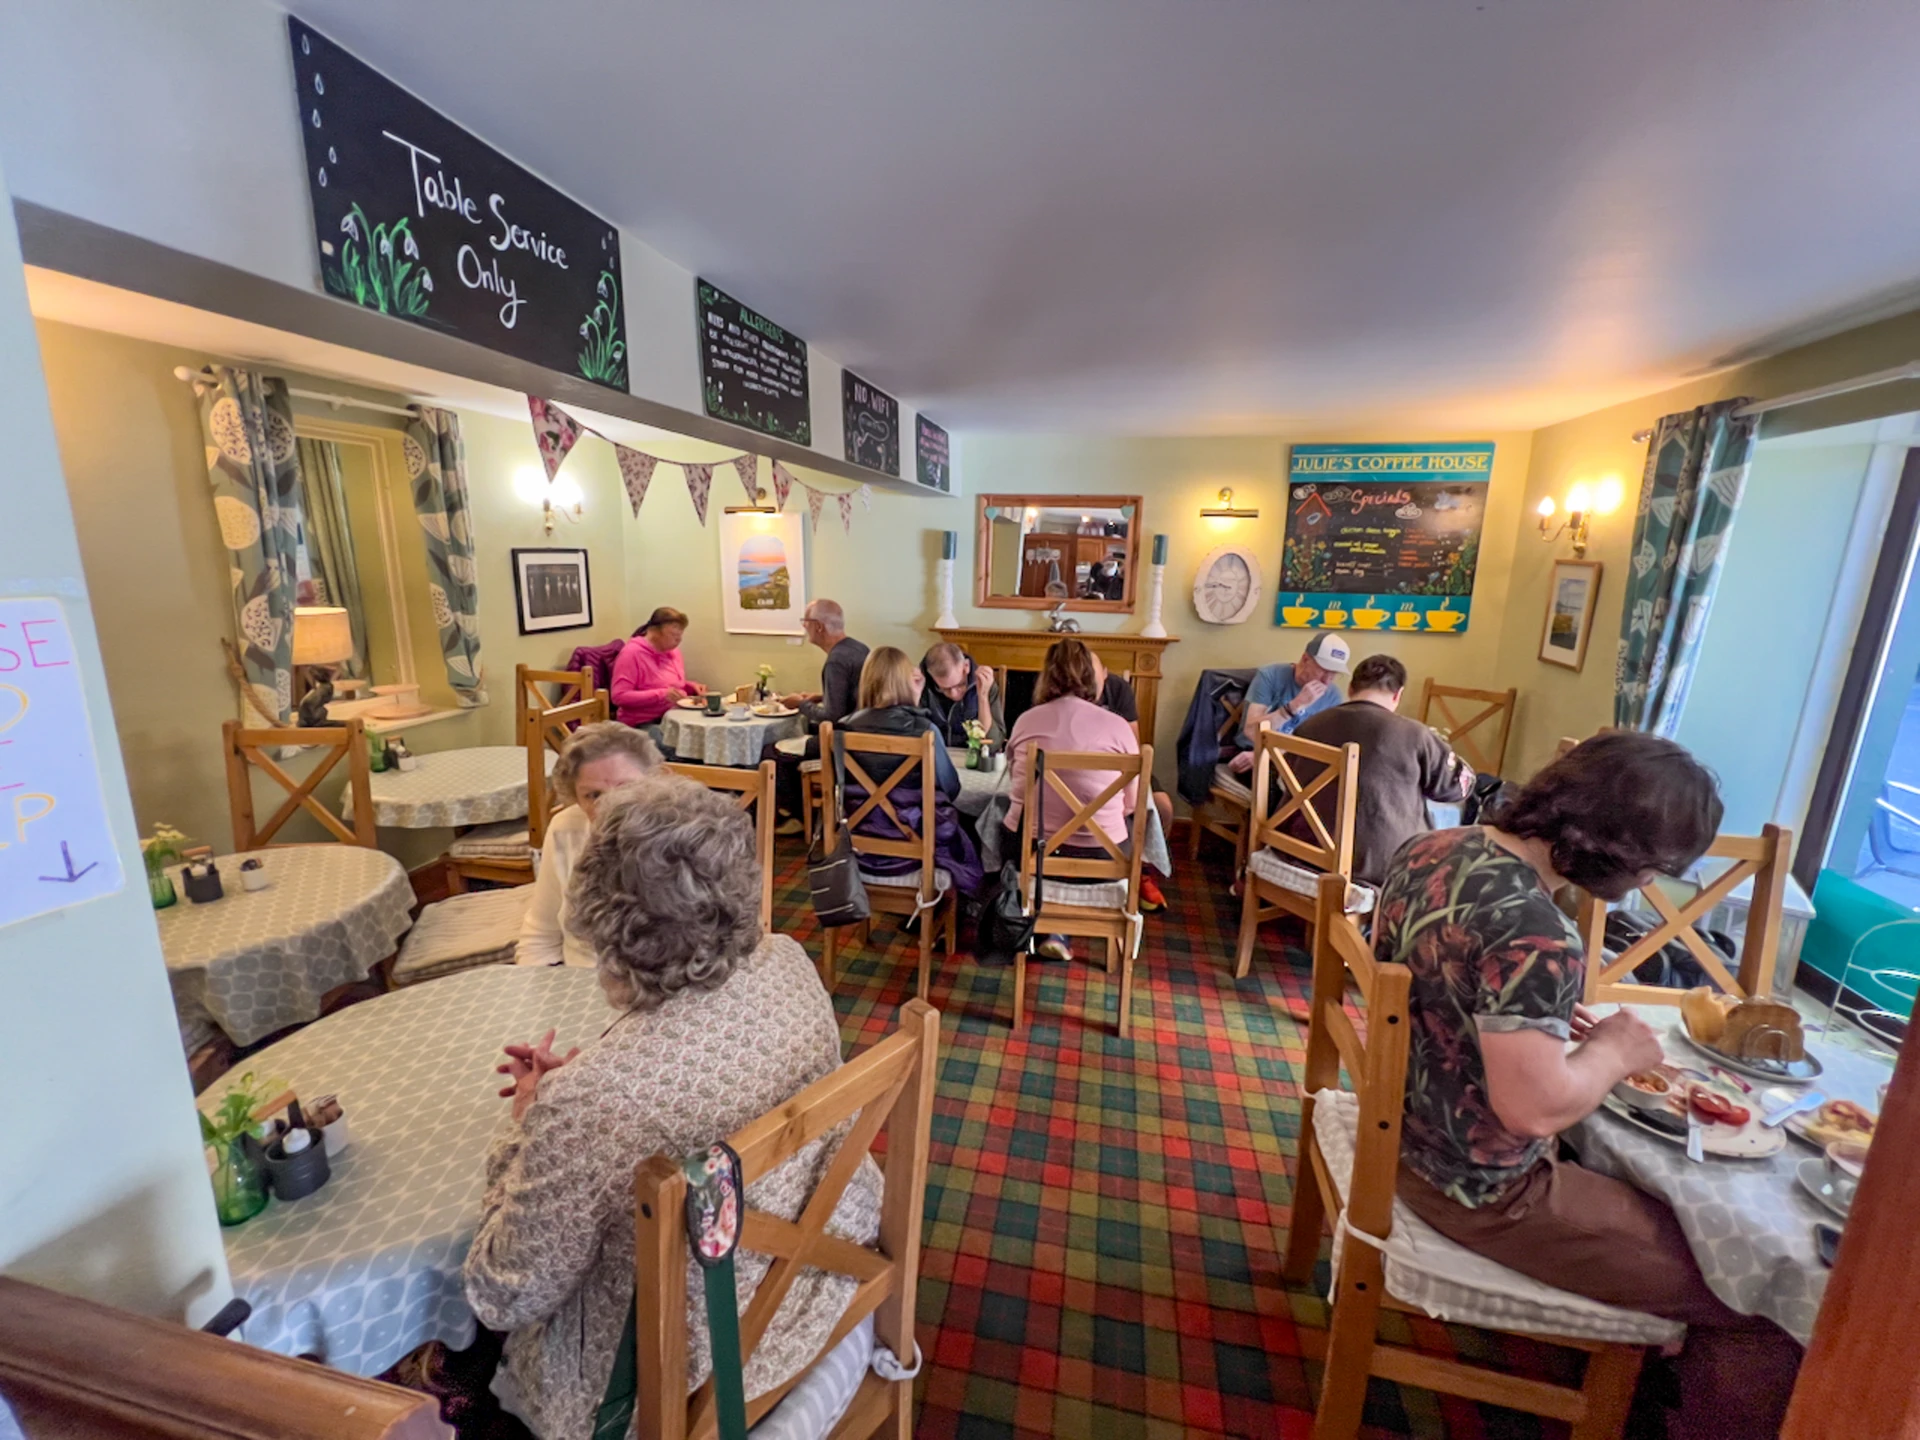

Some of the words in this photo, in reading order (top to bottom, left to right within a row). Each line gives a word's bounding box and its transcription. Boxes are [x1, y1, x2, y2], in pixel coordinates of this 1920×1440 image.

[382, 129, 483, 225] Table
[488, 193, 570, 270] Service
[457, 244, 528, 330] Only
[739, 306, 785, 345] ALLERGENS
[854, 381, 868, 404] NO
[1293, 456, 1353, 471] JULIE'S
[1358, 456, 1422, 470] COFFEE
[1428, 455, 1488, 470] HOUSE
[1350, 487, 1412, 515] Specials
